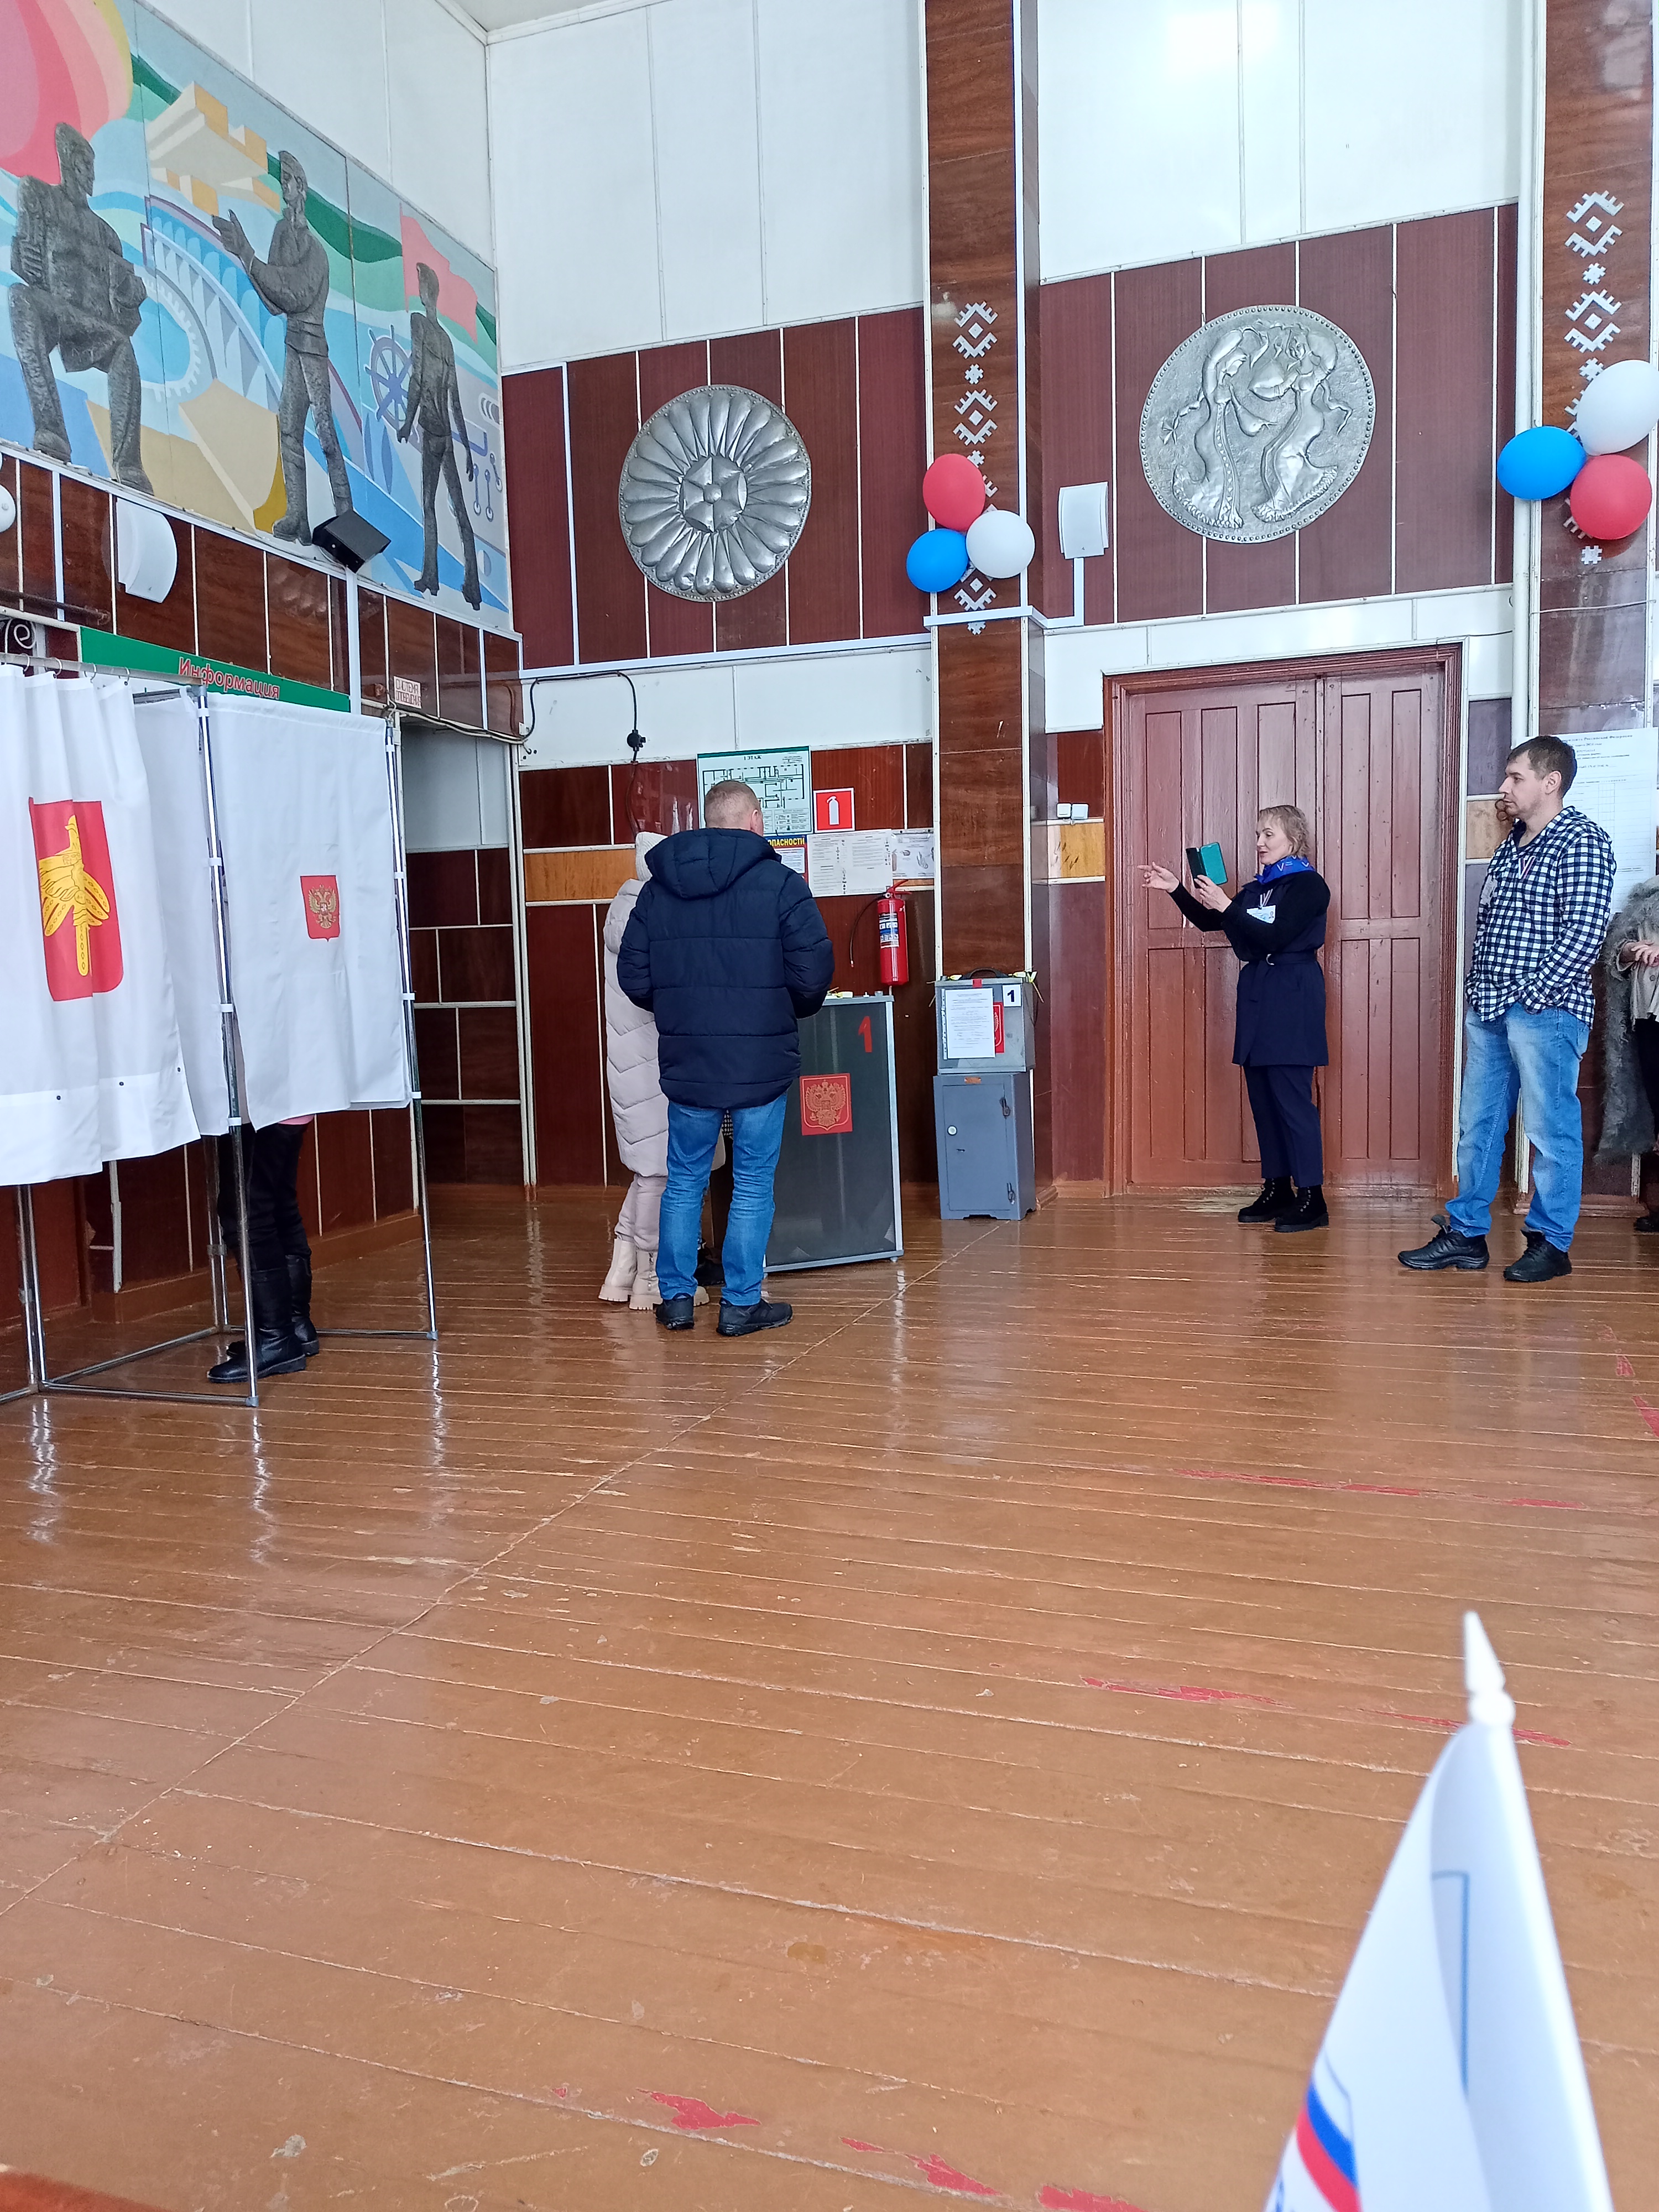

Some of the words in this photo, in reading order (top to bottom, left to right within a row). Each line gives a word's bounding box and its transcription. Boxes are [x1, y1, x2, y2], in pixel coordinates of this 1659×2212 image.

[179, 656, 280, 700] Информация
[1007, 989, 1015, 1002] 1
[858, 1015, 872, 1053] 1
